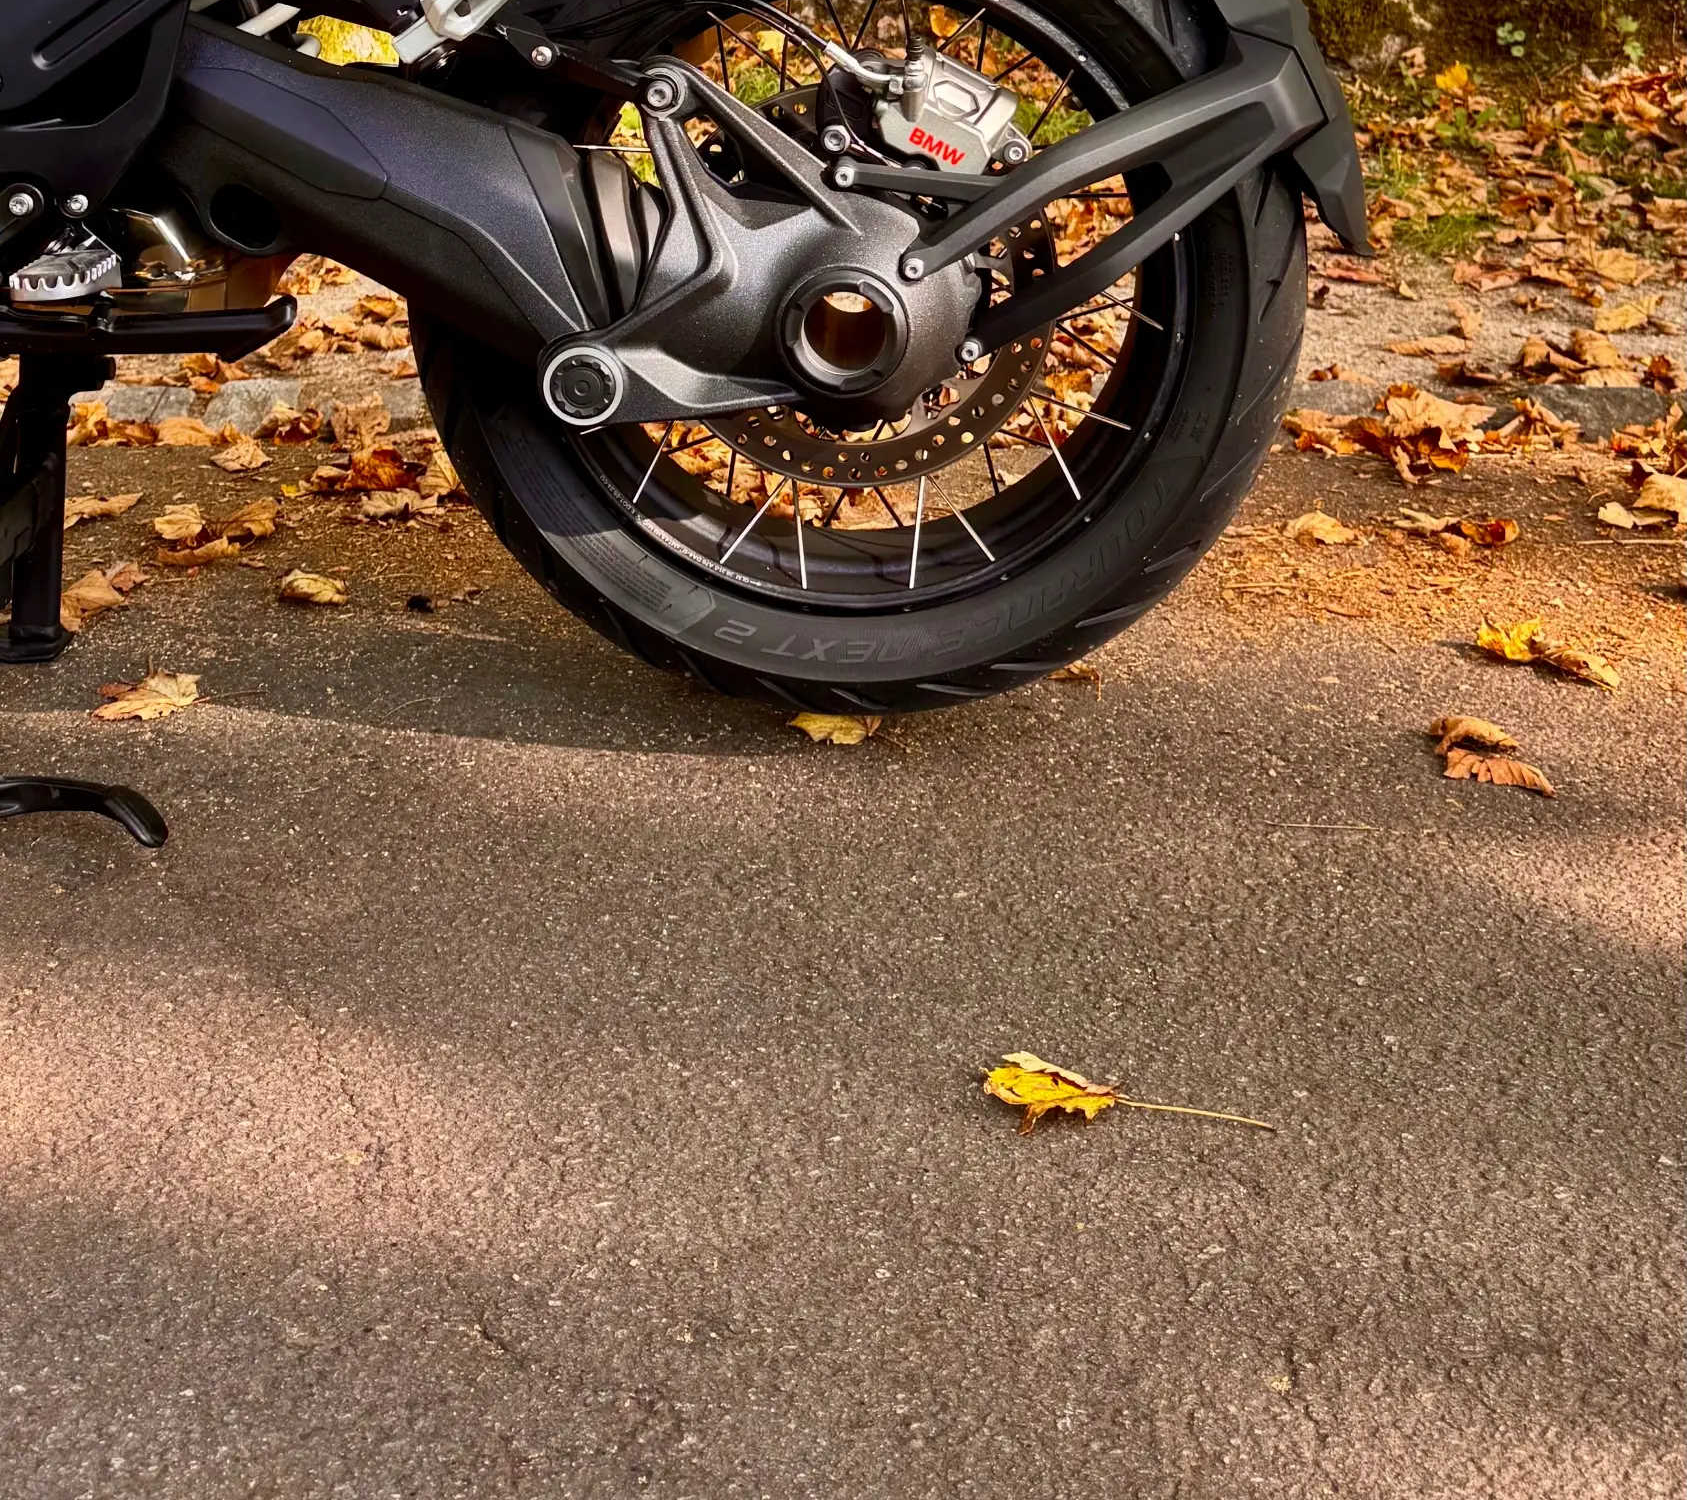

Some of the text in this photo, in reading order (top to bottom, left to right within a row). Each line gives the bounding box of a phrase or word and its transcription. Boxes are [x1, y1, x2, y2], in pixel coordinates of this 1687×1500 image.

[909, 127, 965, 165] BMW
[714, 477, 1173, 663] TOURANCE NEXT 2
